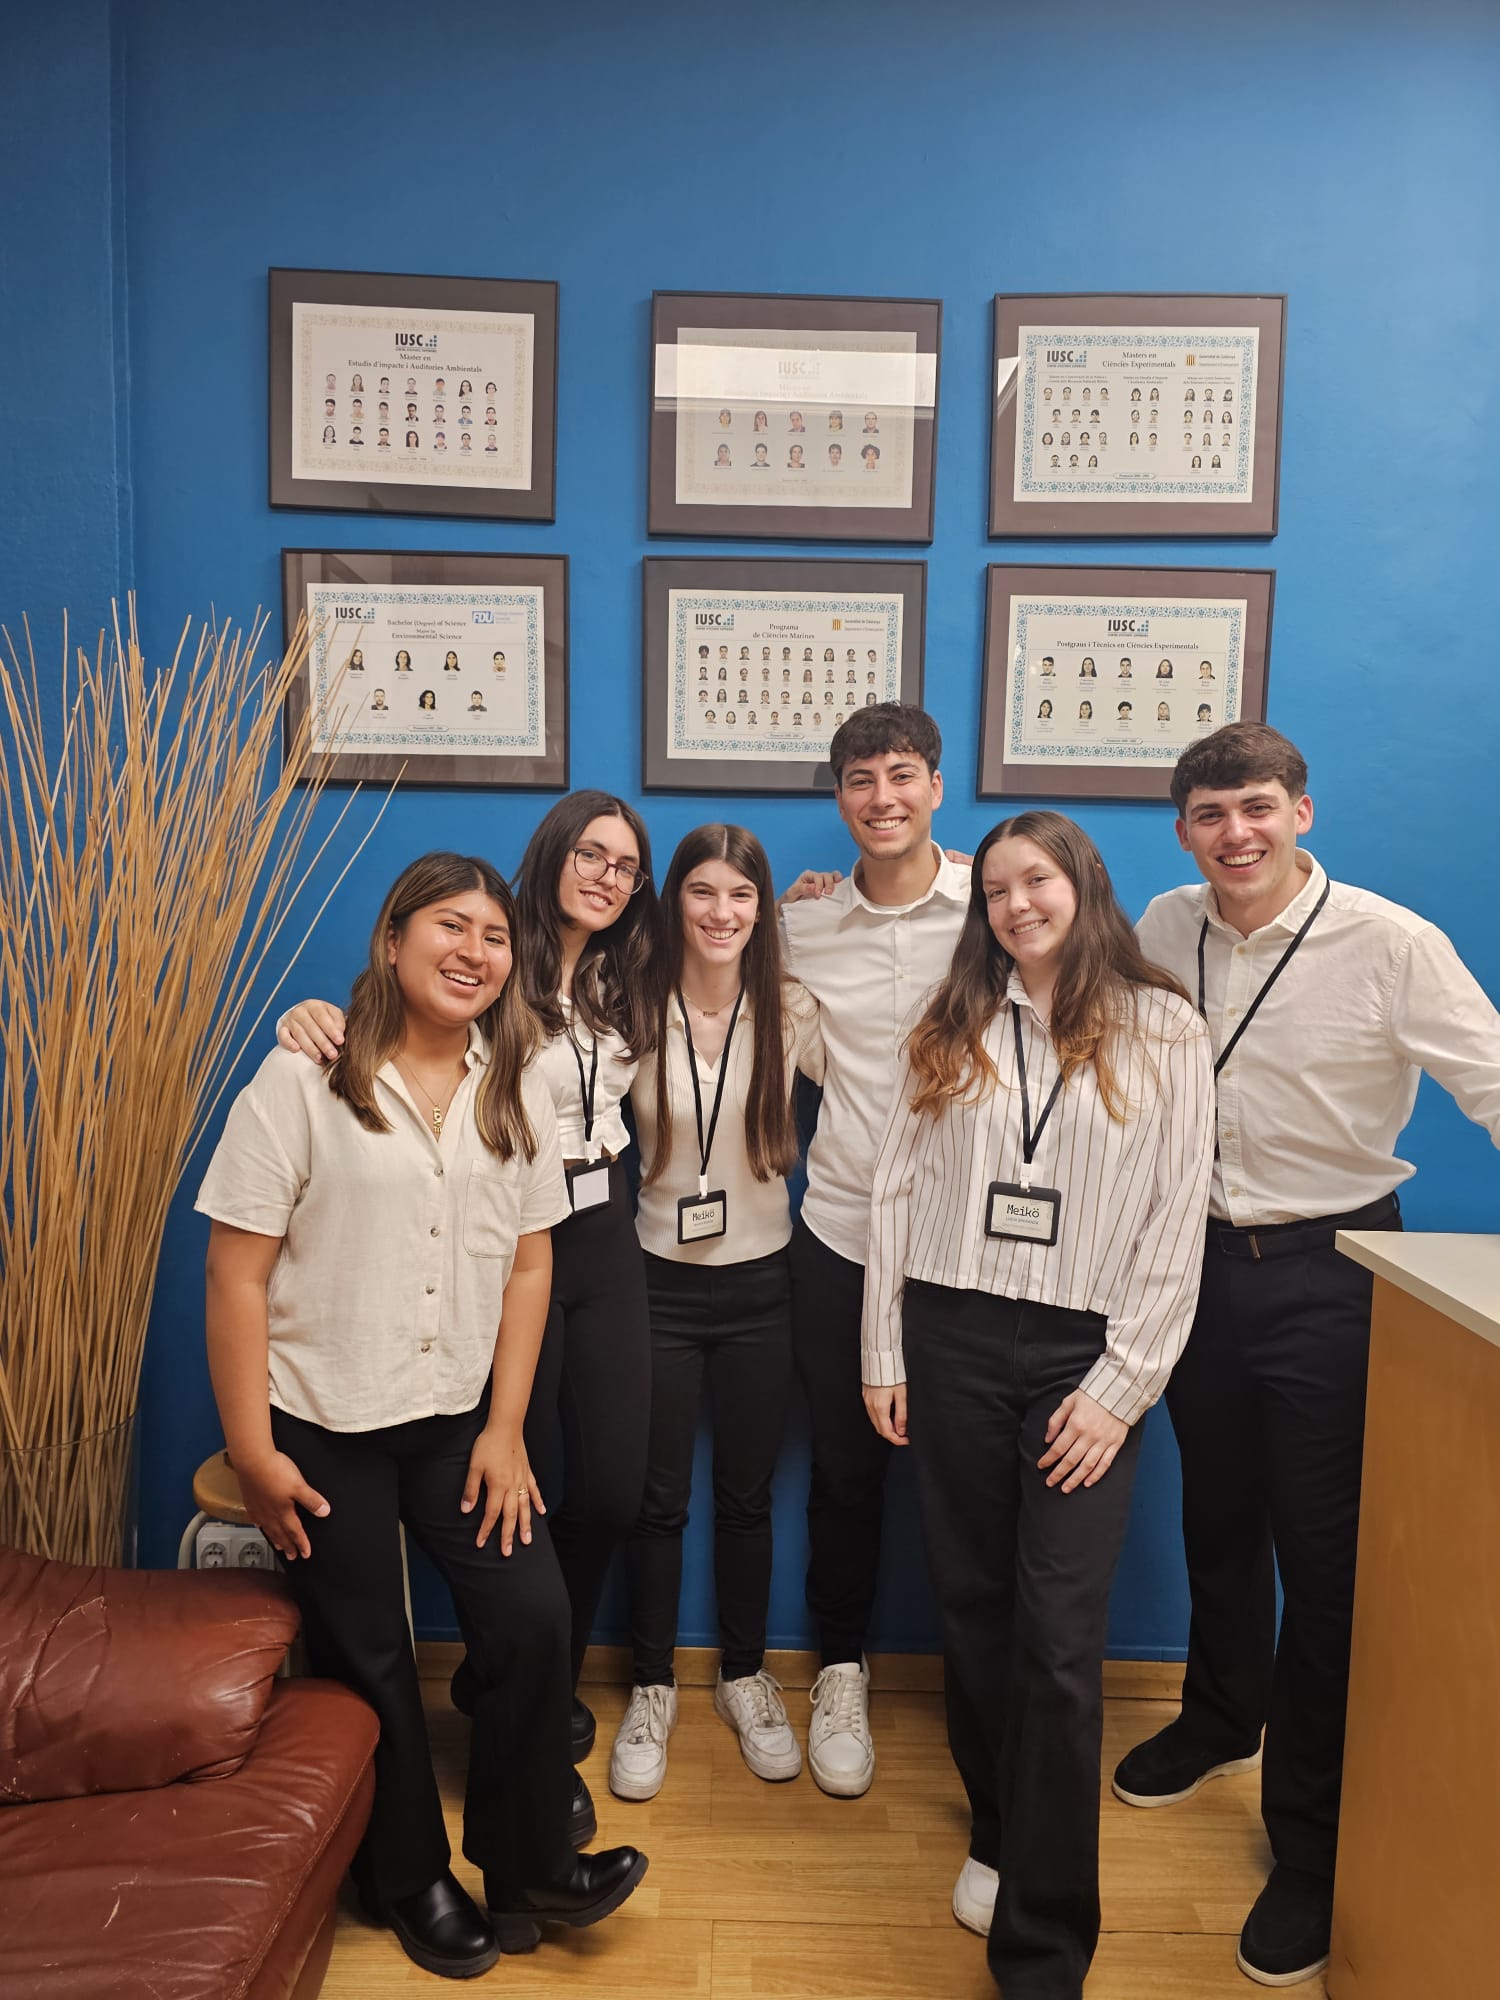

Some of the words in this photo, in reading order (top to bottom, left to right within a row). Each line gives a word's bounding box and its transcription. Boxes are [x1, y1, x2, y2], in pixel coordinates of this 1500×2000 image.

[395, 333, 423, 346] IUSC
[1046, 350, 1074, 363] IUSC
[411, 363, 443, 371] Auditories
[446, 365, 482, 373] Ambientals
[778, 361, 805, 375] IUSC
[1131, 360, 1176, 369] Experimentals
[336, 607, 362, 619] IUSC
[695, 613, 722, 625] IUSC
[769, 623, 799, 632] Programa
[1107, 619, 1136, 632] IUSC
[1056, 640, 1087, 649] Postgraus
[1154, 642, 1199, 650] Experimentals
[1006, 1203, 1040, 1218] Meikö
